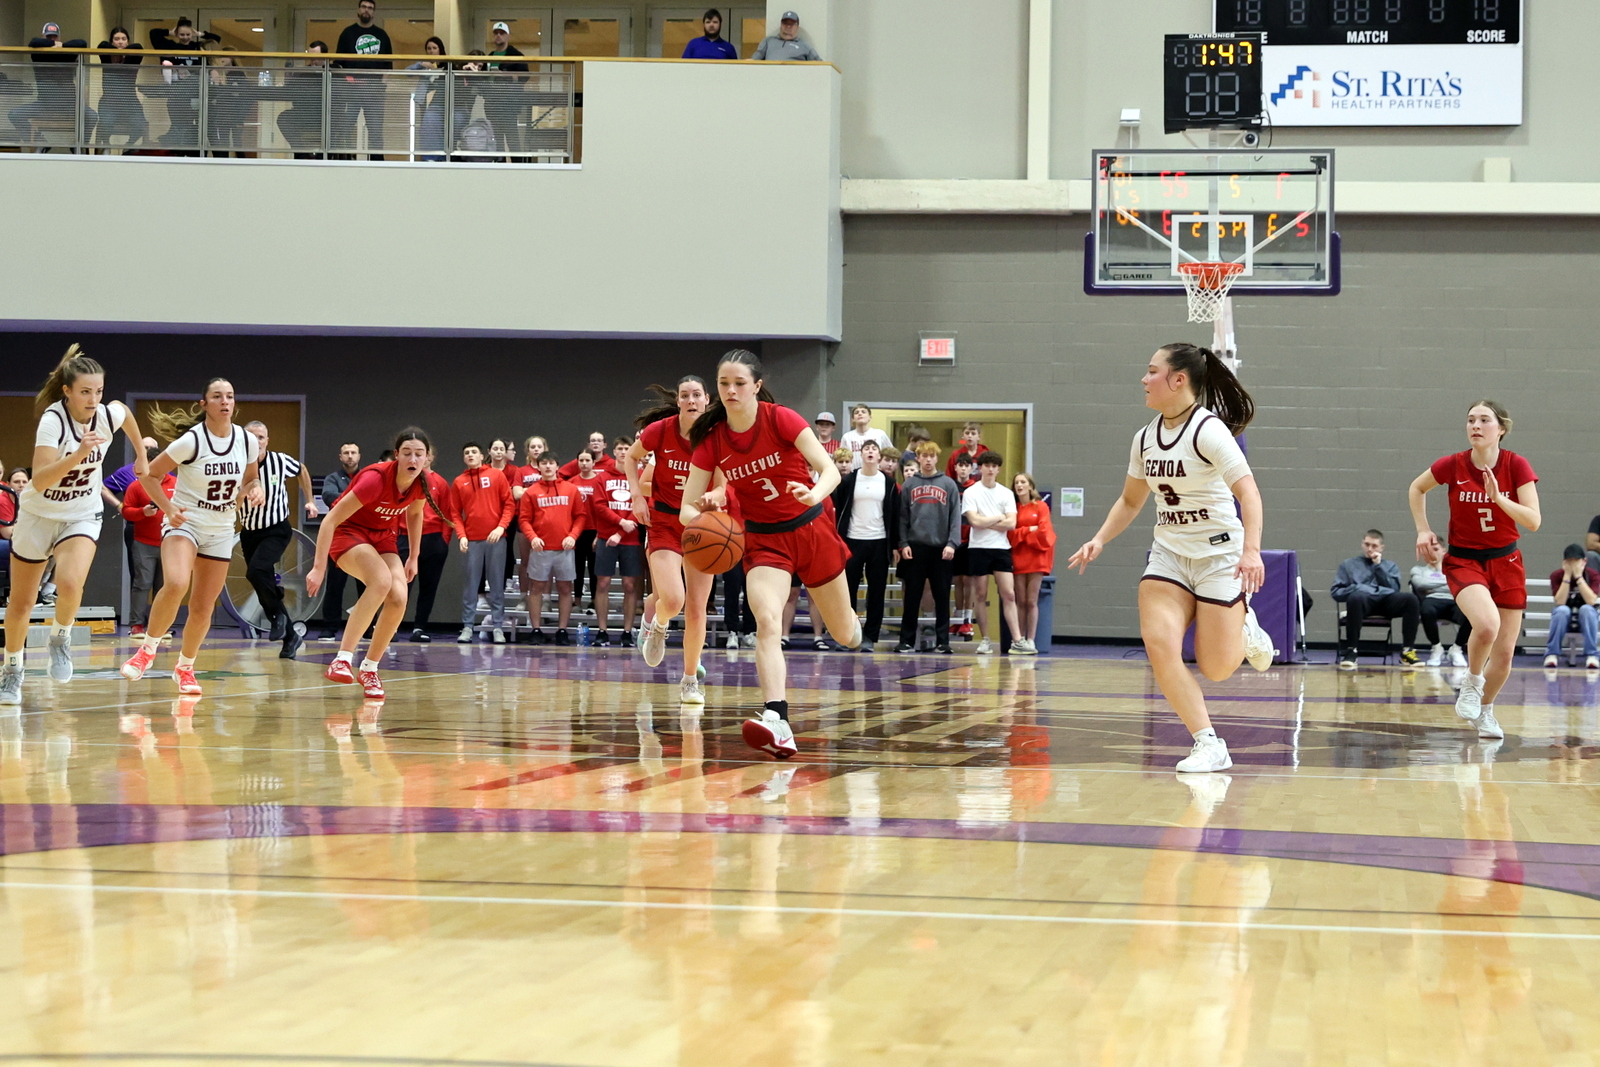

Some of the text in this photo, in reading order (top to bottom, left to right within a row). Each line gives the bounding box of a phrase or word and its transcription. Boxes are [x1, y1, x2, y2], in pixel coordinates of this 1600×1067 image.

[1346, 30, 1389, 44] MATCH
[1466, 29, 1506, 43] SCORE
[1201, 41, 1253, 66] 1:47
[1331, 99, 1461, 109] HEALTH PARTNERS
[926, 339, 951, 357] EXIT
[204, 461, 240, 476] GENOA
[668, 459, 691, 472] BELL
[725, 451, 782, 482] BELLEVUE
[1145, 459, 1187, 477] GENOA
[207, 479, 237, 501] 23
[480, 476, 491, 489] B
[673, 474, 688, 490] 3
[752, 477, 780, 502] 3
[537, 495, 569, 508] BELLEVUE
[1157, 483, 1181, 506] 3
[1477, 508, 1496, 532] 2
